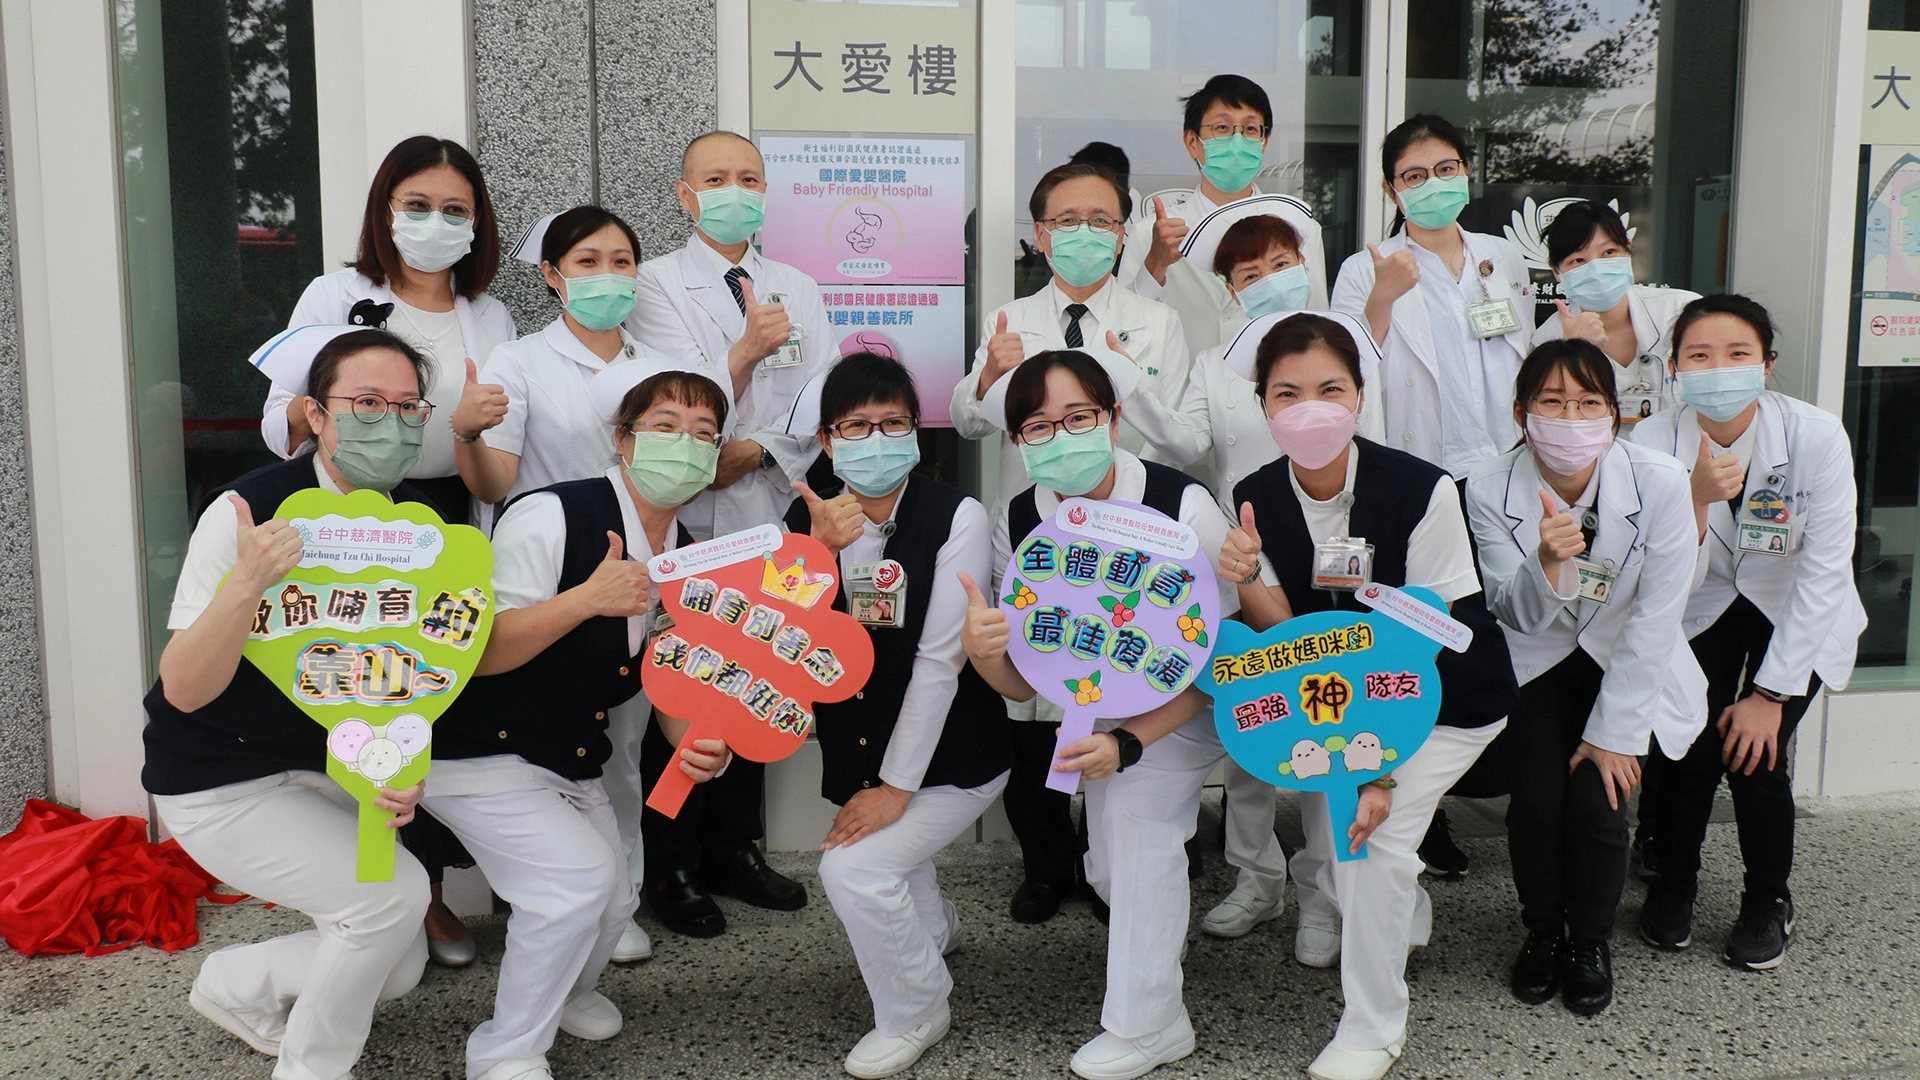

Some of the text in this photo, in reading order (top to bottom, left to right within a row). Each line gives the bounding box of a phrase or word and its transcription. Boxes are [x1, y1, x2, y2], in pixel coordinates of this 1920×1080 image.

[773, 40, 957, 96] 大愛樓
[1870, 65, 1912, 110] 大
[793, 183, 933, 198] Baby Friendly Hospital
[819, 168, 907, 183] 國際愛嬰醫院
[302, 549, 411, 564] Taichung Tzu Chi Hospital
[318, 526, 413, 545] 台中慈濟醫院
[1023, 540, 1189, 605] 全體動員
[1029, 610, 1190, 690] 最佳後援
[1214, 624, 1373, 684] 永遠做媽咪的
[1235, 672, 1420, 731] 最強 神 隊友
